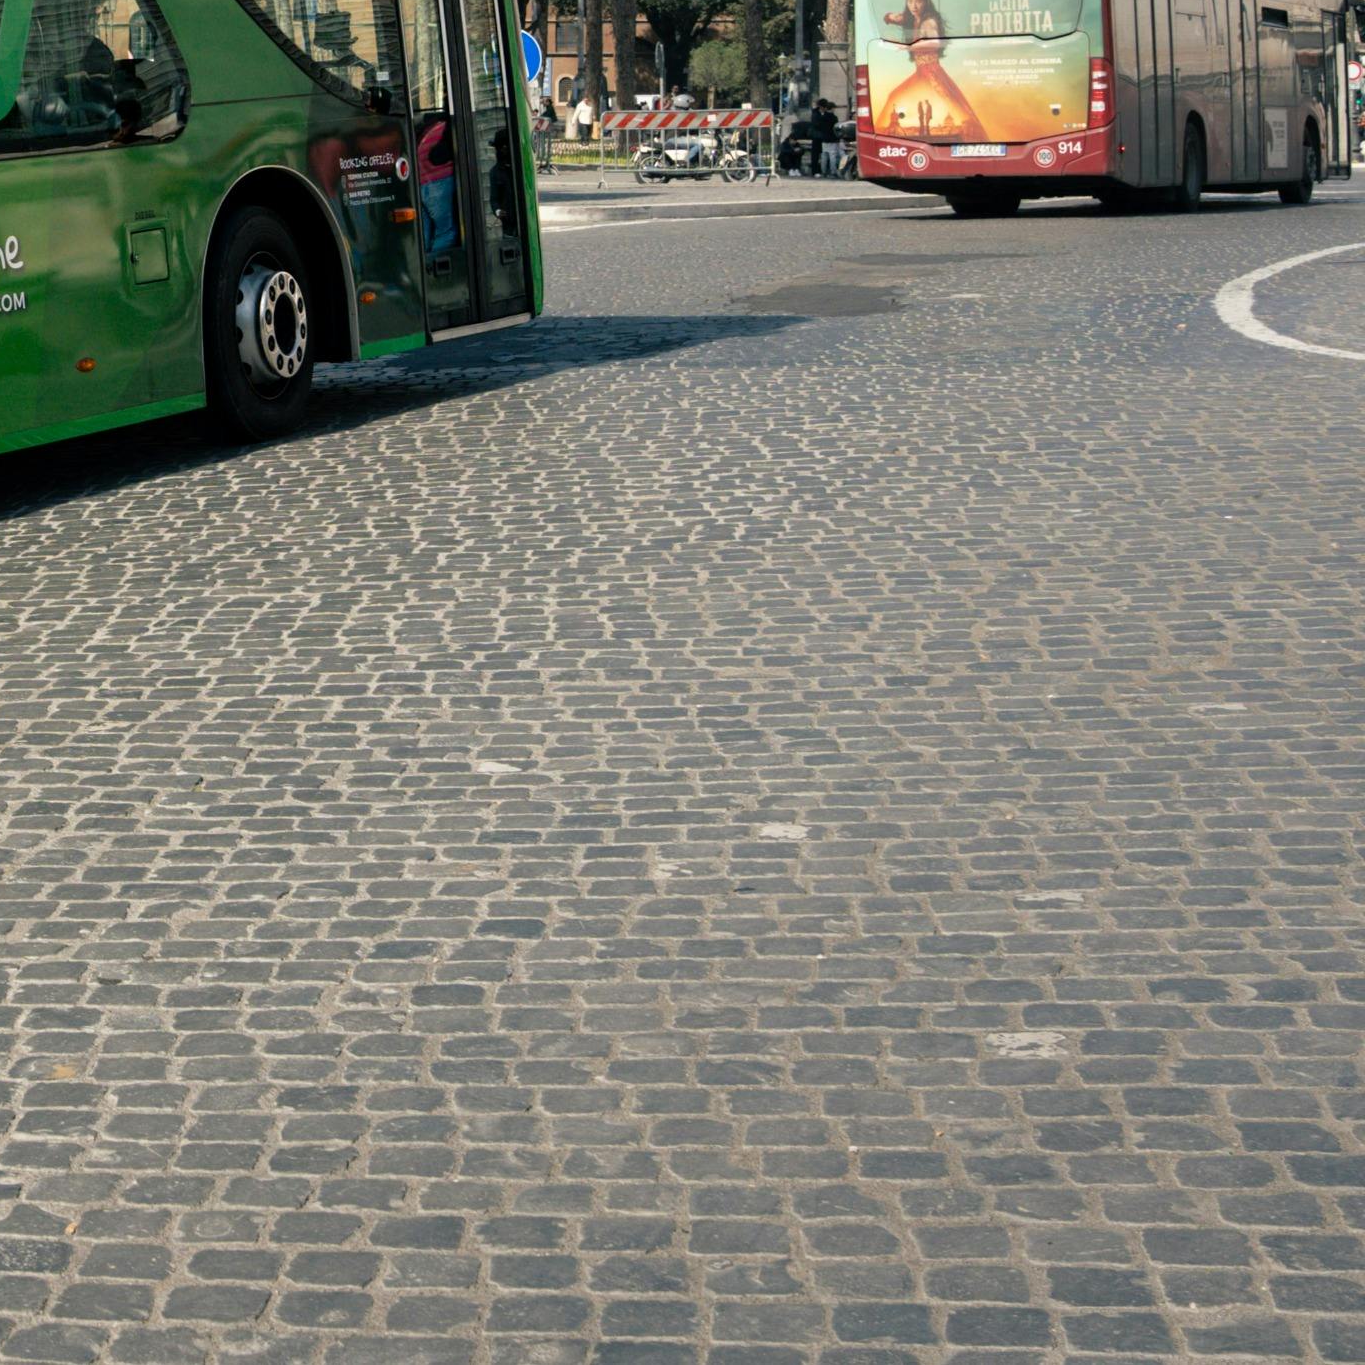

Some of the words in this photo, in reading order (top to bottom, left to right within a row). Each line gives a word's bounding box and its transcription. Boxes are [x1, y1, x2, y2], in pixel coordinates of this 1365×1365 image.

[989, 1, 999, 12] LA
[970, 10, 1054, 35] PROIBITA
[879, 146, 908, 158] atac
[1058, 141, 1082, 154] 914
[914, 156, 924, 166] 80
